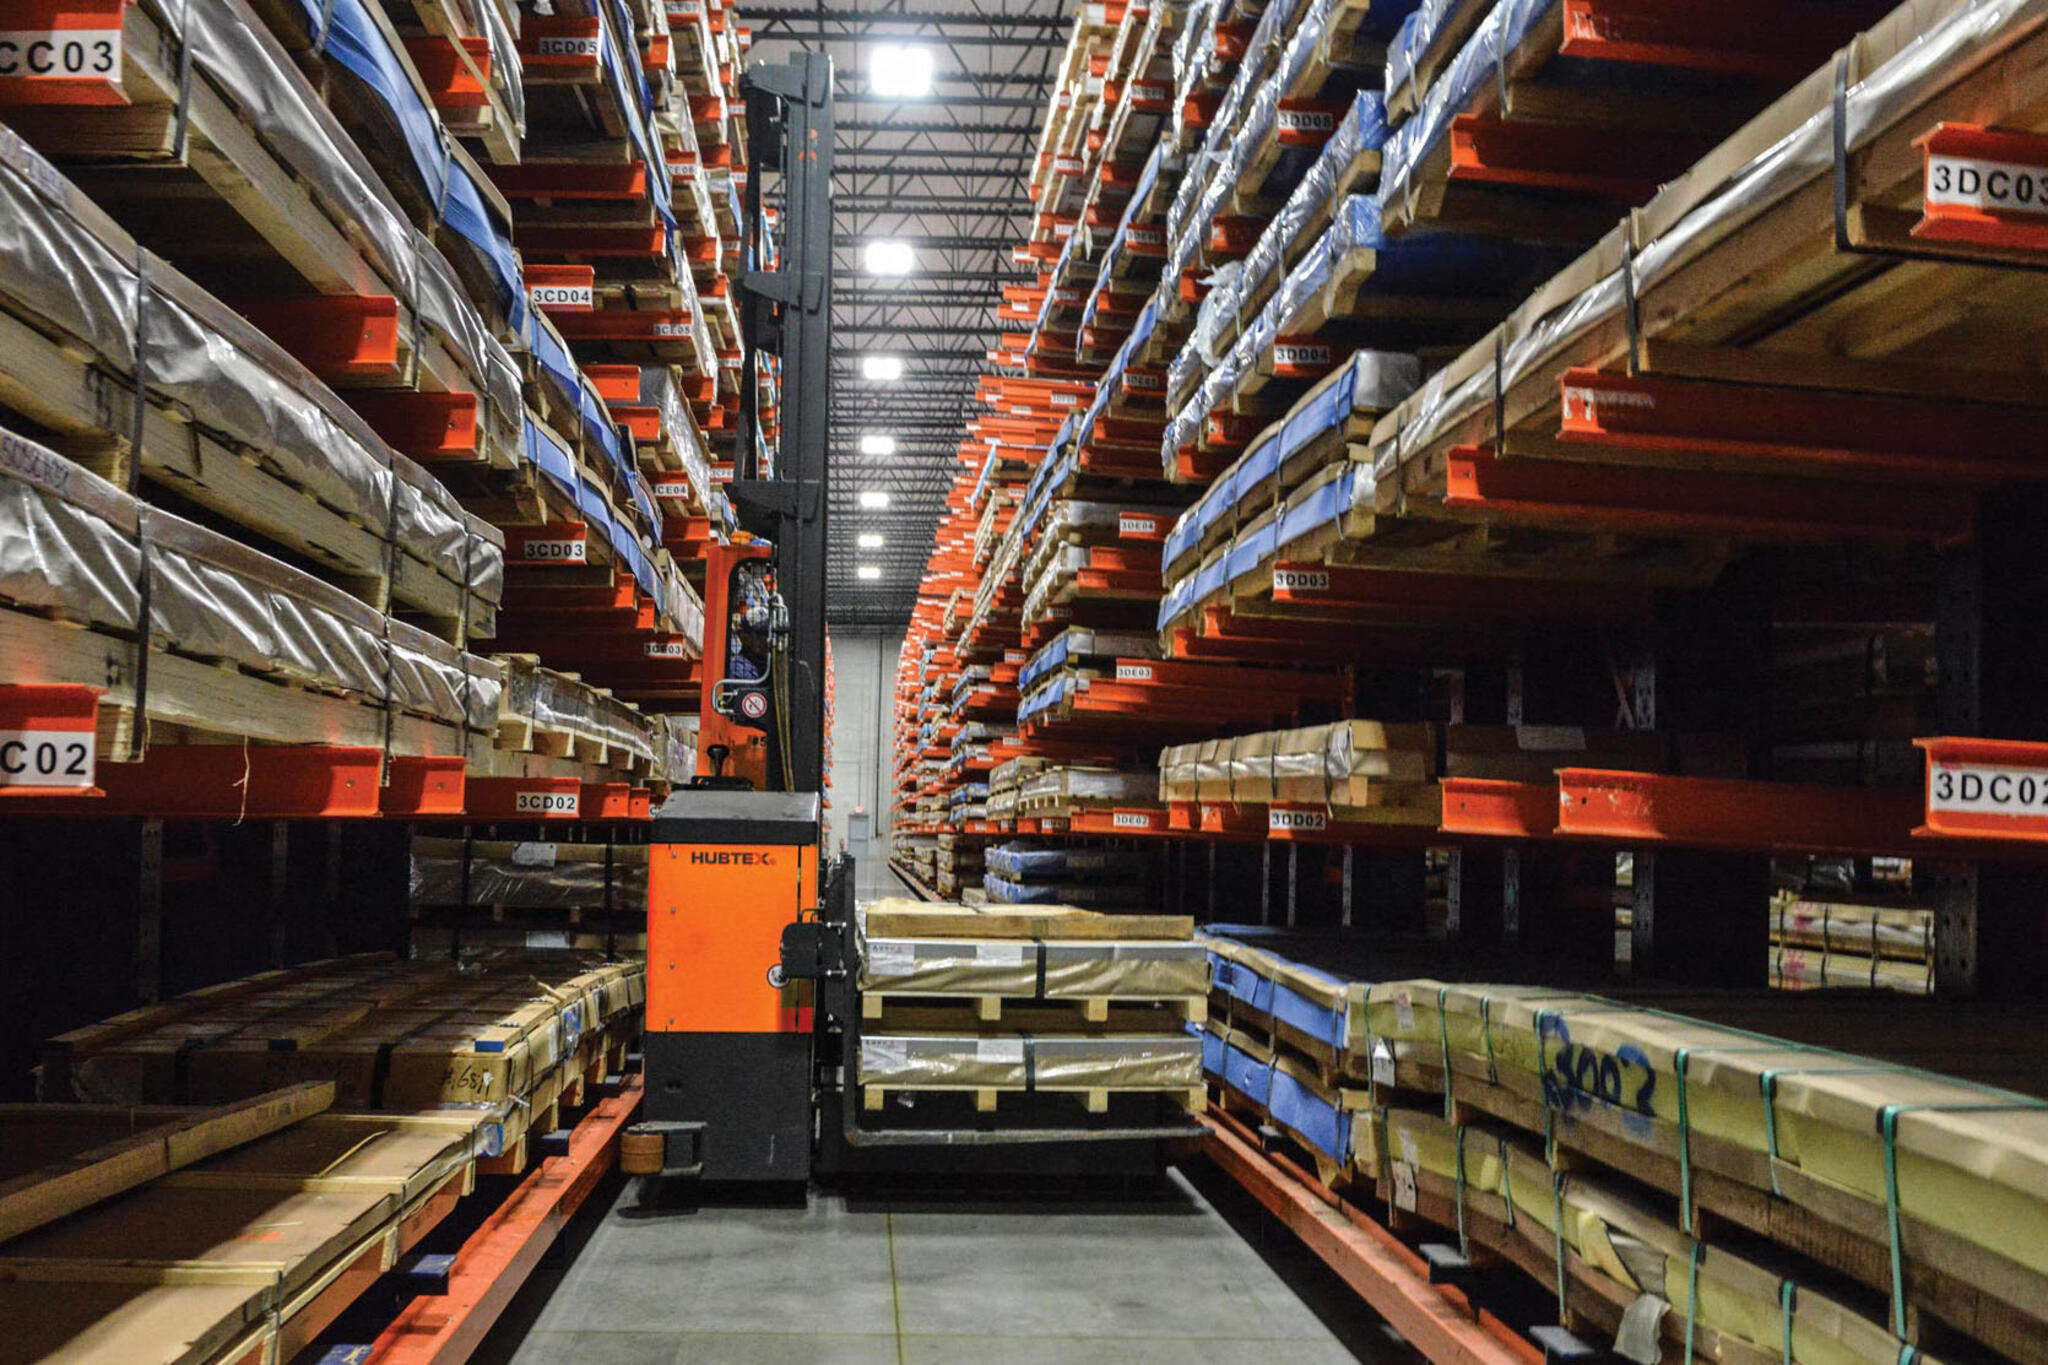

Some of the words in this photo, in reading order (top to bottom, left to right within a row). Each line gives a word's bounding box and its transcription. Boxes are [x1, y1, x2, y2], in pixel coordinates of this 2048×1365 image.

[542, 41, 597, 53] 3CD05
[0, 41, 113, 74] CC03
[534, 290, 589, 302] 3CD04
[1277, 347, 1329, 360] 3DD04
[527, 543, 583, 557] 3CD03
[1276, 573, 1327, 586] 3DD03
[519, 795, 576, 810] 3CD02
[1272, 812, 1324, 827] 3DD02
[691, 850, 769, 865] HUBTEX
